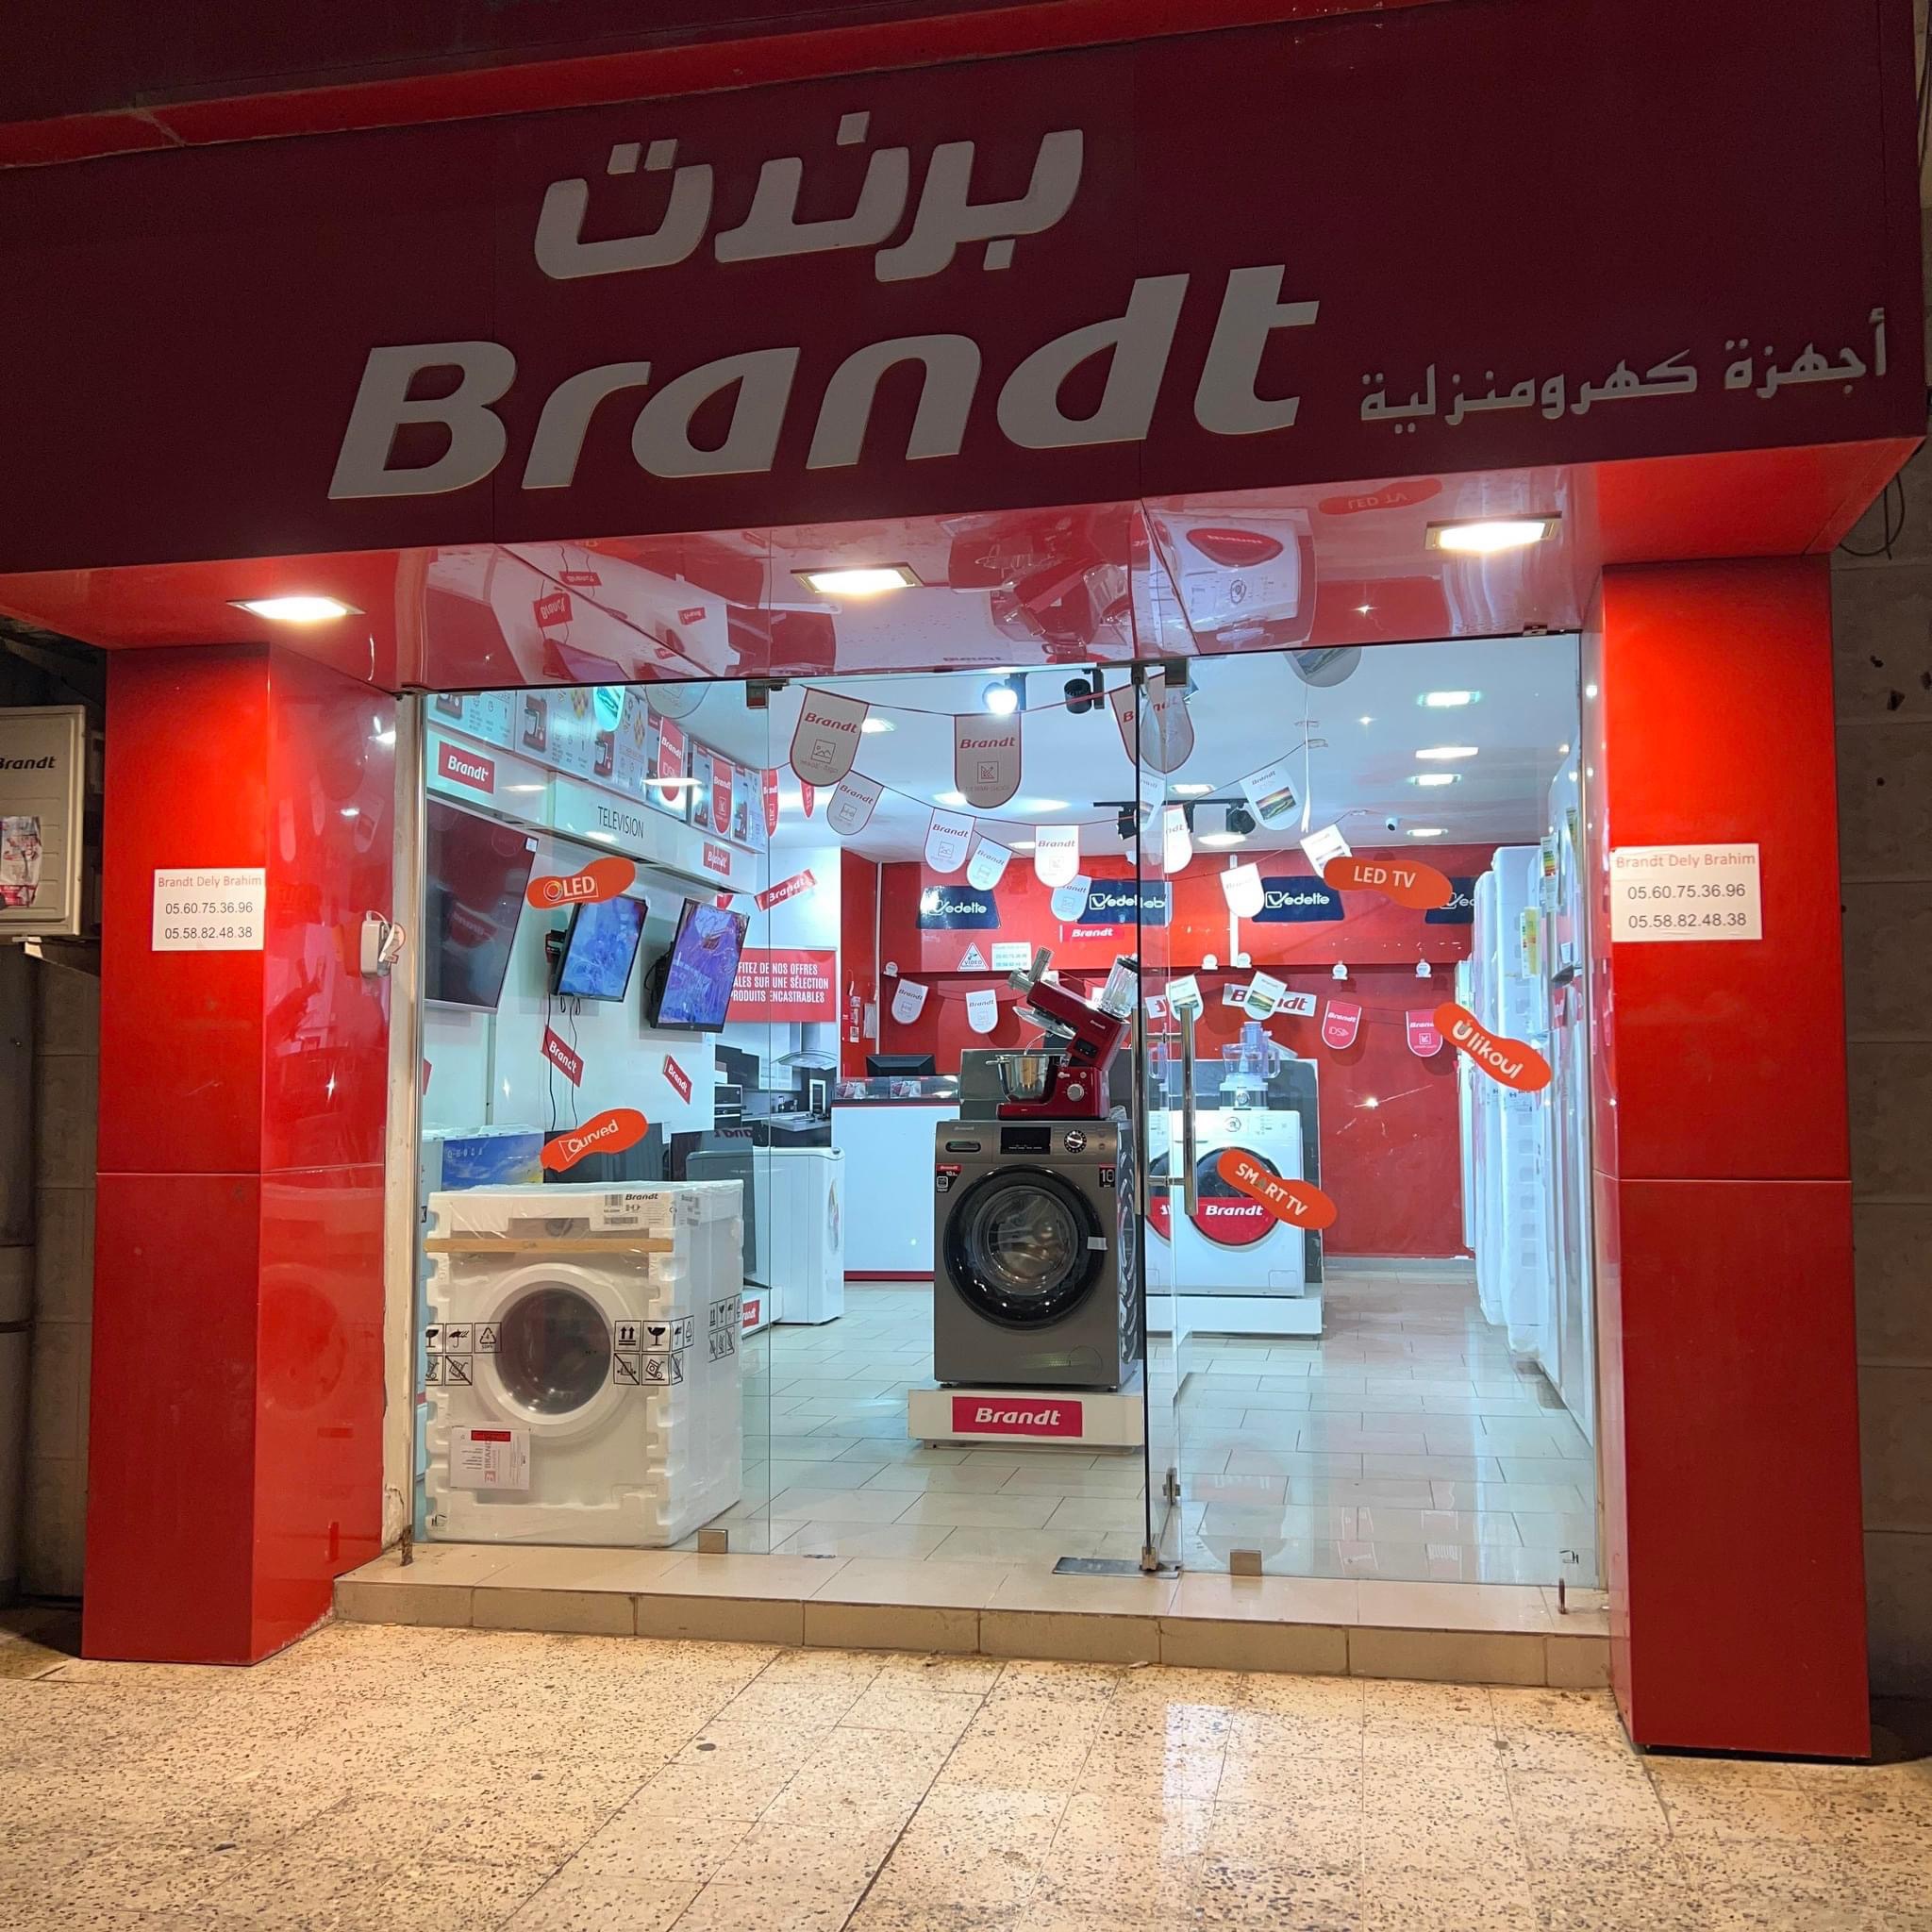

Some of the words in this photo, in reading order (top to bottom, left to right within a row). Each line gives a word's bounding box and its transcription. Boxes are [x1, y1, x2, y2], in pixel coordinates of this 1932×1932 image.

[534, 110, 1084, 283] برنت
[1724, 308, 1888, 399] أجهزة
[326, 264, 1320, 500] Brandt
[1360, 349, 1698, 435] كهرومنزلية
[805, 712, 858, 733] Brandt
[661, 737, 682, 759] Brandt
[959, 737, 1016, 749] Brandt
[447, 755, 489, 782] Brandt
[840, 784, 874, 805] Brandt
[597, 806, 644, 839] TELEVISION
[932, 824, 969, 838] Brandt
[1038, 840, 1075, 848] Brandt
[976, 849, 1005, 866] Brandt
[1616, 855, 1663, 869] Brandt
[1669, 854, 1700, 868] Dely
[1705, 852, 1756, 866] Brahim
[158, 876, 193, 888] Brandt
[196, 875, 221, 889] Dely
[223, 875, 262, 887] Brahim
[1354, 865, 1387, 884] LED
[1392, 870, 1416, 888] TV
[1265, 891, 1330, 908] Vedette
[1627, 883, 1746, 900] 05.60.75.36.96
[165, 901, 253, 915] 05.60.75.36.96
[1628, 912, 1747, 928] 05.58.82.48.38
[164, 926, 253, 940] 05.58.82.48.38
[1071, 927, 1114, 937] Brandt
[738, 962, 758, 974] FITEZ
[759, 962, 770, 974] DE
[772, 962, 788, 974] NOS
[791, 963, 818, 975] OFFRES
[754, 975, 770, 988] SUR
[773, 976, 788, 988] UNE
[791, 975, 829, 989] SÉLECTION
[770, 991, 824, 1003] ENCASTRABLES
[898, 989, 923, 1000] Brandt
[969, 999, 994, 1008] Brandt
[549, 1040, 577, 1074] Brandt
[668, 1065, 689, 1093] Brandt
[568, 1119, 619, 1153] Curved
[625, 1192, 658, 1201] Brandt
[1286, 1194, 1308, 1216] TV
[1206, 1205, 1264, 1216] Brandt
[974, 1407, 1061, 1426] Brandt
